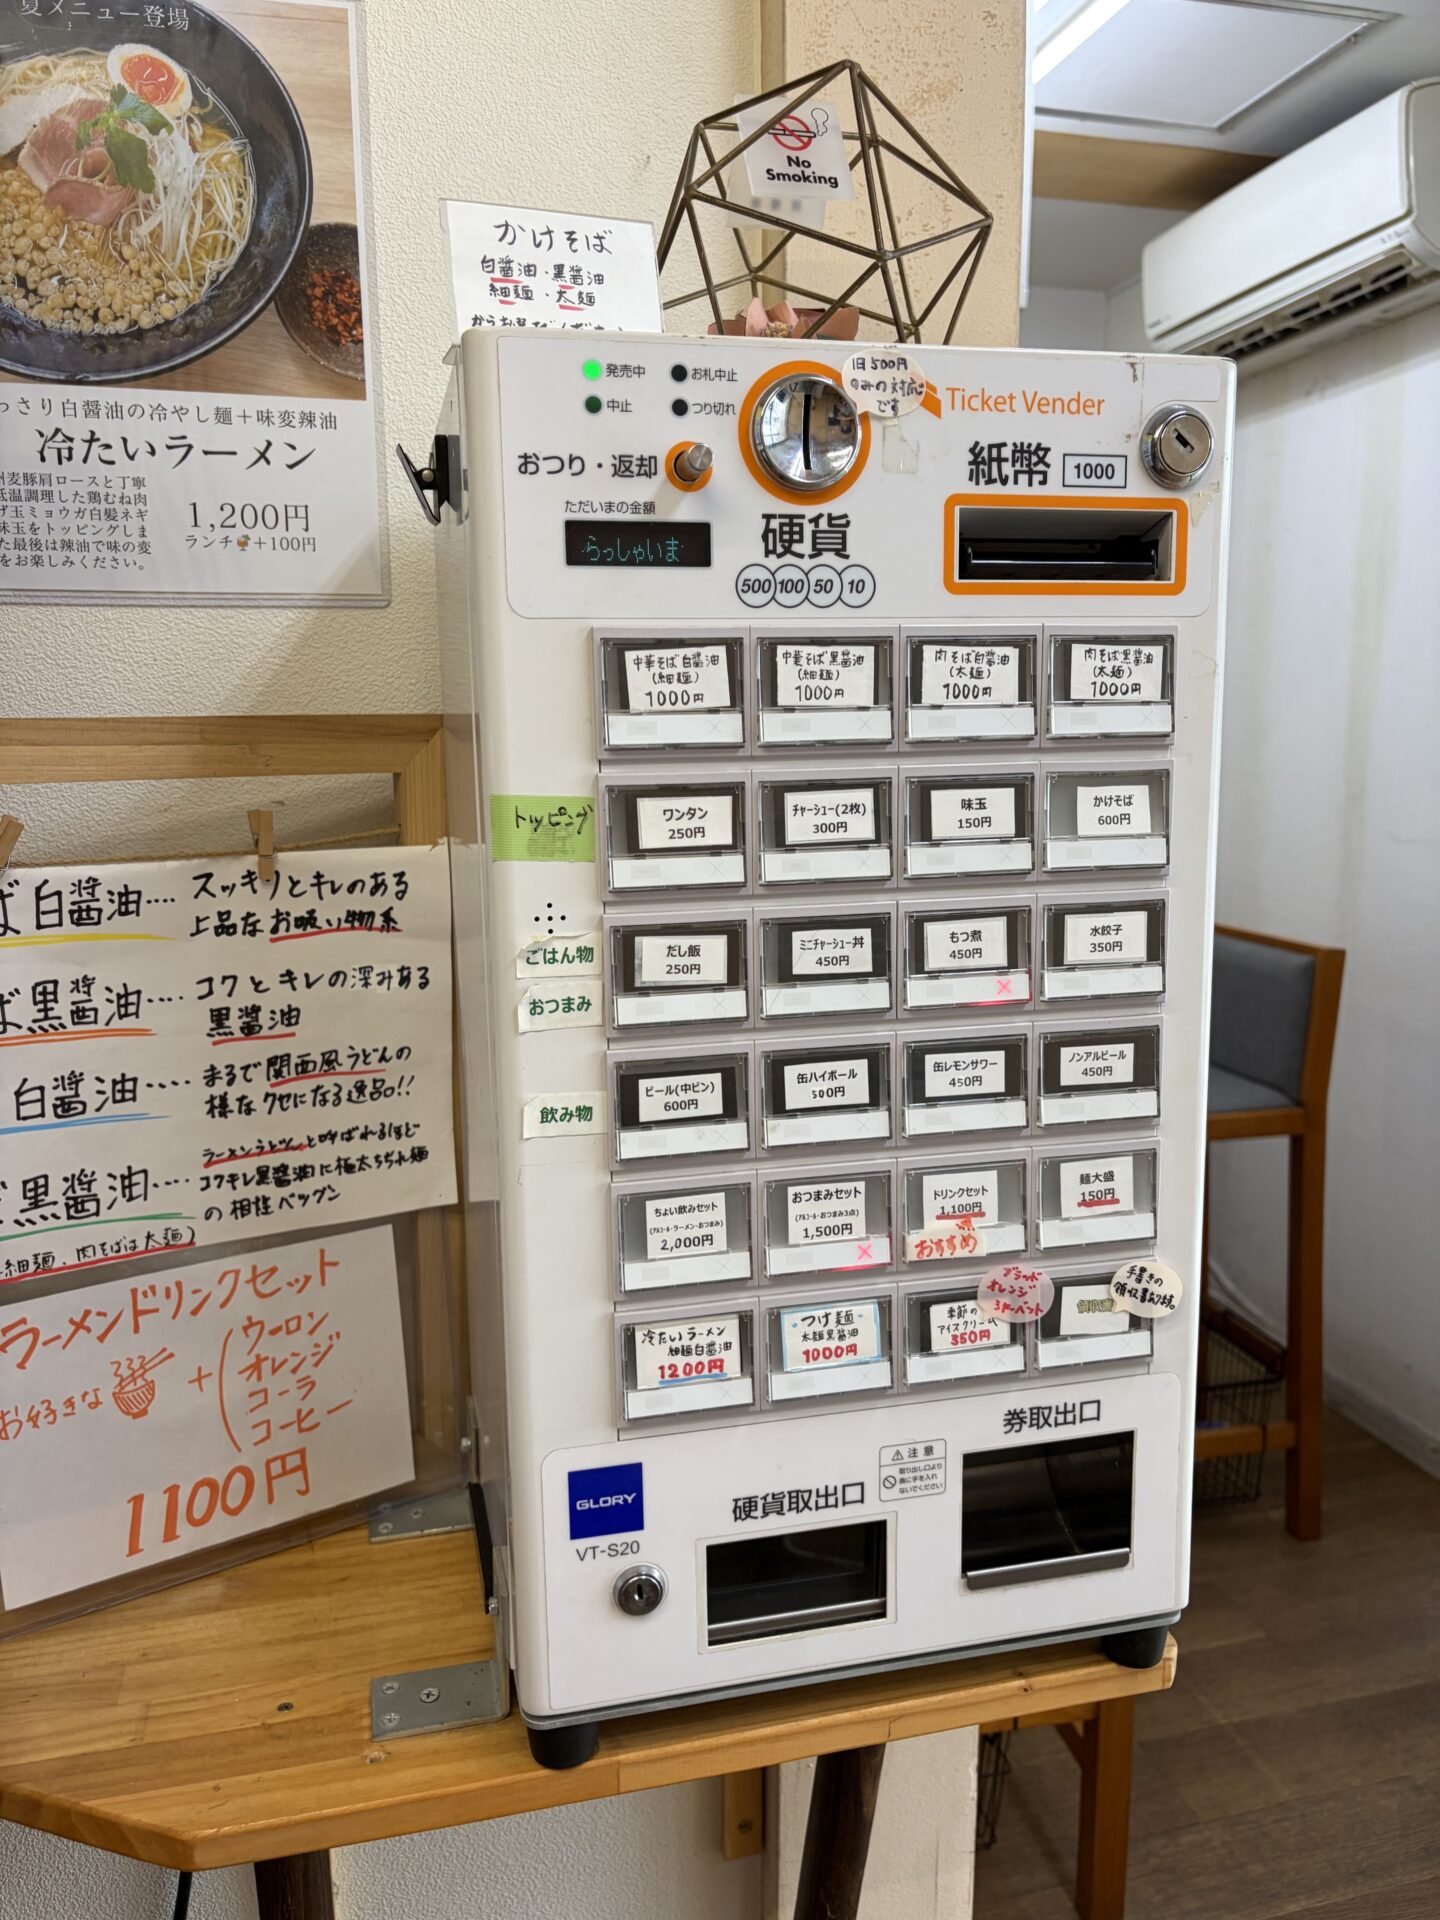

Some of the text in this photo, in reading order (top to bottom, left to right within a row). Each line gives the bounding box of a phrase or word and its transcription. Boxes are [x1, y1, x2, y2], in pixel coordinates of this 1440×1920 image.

[20, 0, 190, 31] 夏メニュー登場
[786, 155, 811, 168] No
[766, 168, 838, 188] Smoking
[493, 219, 613, 255] かけそば
[605, 364, 646, 379] 発売中
[691, 367, 738, 382] お札中止
[607, 399, 633, 413] 中止
[691, 401, 736, 416] つり切れ
[876, 397, 900, 417] です
[945, 387, 1105, 416] Ticket Vender
[35, 427, 317, 470] 冷たいラーメン
[517, 453, 657, 479] おつり・返却
[967, 440, 1115, 487] 紙幣 1000
[563, 500, 656, 515] ただいまの金額
[189, 502, 310, 533] 1,200円
[761, 513, 851, 560] 硬貨
[740, 579, 865, 594] 500 100 50 10
[633, 651, 720, 672] 中華そば白醤油
[934, 648, 1010, 667] 肉そば白醤油
[794, 685, 845, 702] 1000円
[942, 682, 992, 700] 1000円
[1091, 680, 1142, 698] 1000円
[644, 690, 704, 707] 1000円
[961, 797, 987, 812] 味玉
[1093, 794, 1135, 808] かけそば
[515, 804, 594, 835] トッピング
[662, 806, 708, 823] ワンタン
[957, 816, 992, 829] 150円
[1098, 813, 1131, 826] 600円
[668, 826, 706, 841] 250円
[812, 821, 848, 834] 300円
[949, 929, 983, 944] もつ煮
[1089, 924, 1123, 937] 水餃子
[525, 946, 594, 965] ごはん物
[666, 944, 701, 959] だし飯
[949, 947, 983, 960] 450円
[1089, 941, 1123, 953] 350円
[665, 963, 701, 976] 250円
[815, 955, 850, 967] 450円
[197, 965, 431, 1001] コクとキレの深みある
[529, 996, 592, 1016] おつまみ
[206, 1003, 301, 1037] 黒醤油
[1068, 1049, 1127, 1063] ノンアルビール
[202, 1045, 412, 1088] まるで関西風うどんの
[933, 1059, 998, 1073] 缶レモンサワー
[1081, 1065, 1113, 1077] 450円
[796, 1068, 858, 1084] 缶ハイボール
[948, 1075, 983, 1088] 450円
[645, 1081, 715, 1098] ビール(中ビン)
[811, 1086, 845, 1100] 500円
[539, 1105, 593, 1124] 飲み物
[663, 1099, 699, 1112] 600円
[1079, 1171, 1115, 1186] 麺大盛
[792, 1186, 862, 1204] おつまみセット
[933, 1185, 989, 1200] ドリンクセット
[1080, 1188, 1115, 1202] 150円
[654, 1201, 718, 1217] ちょい飲みセット
[940, 1201, 982, 1216] 1,100円
[803, 1223, 853, 1240] 1,500円
[660, 1233, 714, 1252] 2,000円
[914, 1233, 978, 1260] おすすめ
[1126, 1265, 1163, 1287] 手書きの
[986, 1278, 1036, 1298] オレンジ
[0, 1248, 340, 1370] ラーメンドリンクセット
[800, 1308, 855, 1328] つけ麺
[947, 1304, 977, 1320] 季節の
[241, 1311, 329, 1355] ウーロン
[641, 1325, 727, 1347] 冷たいラーメン
[950, 1329, 991, 1346] 350円
[802, 1343, 858, 1364] 1000円
[658, 1357, 725, 1380] 1200円
[0, 1389, 103, 1441] お好きな
[238, 1332, 341, 1382] オレンジ
[247, 1376, 317, 1413] コーラ
[252, 1399, 354, 1446] コーヒー
[1002, 1400, 1101, 1436] 券取出口
[125, 1446, 310, 1557] 1100円
[576, 1492, 637, 1511] GLORY
[732, 1481, 865, 1523] 硬貨取出口
[576, 1540, 640, 1562] VT-S20
